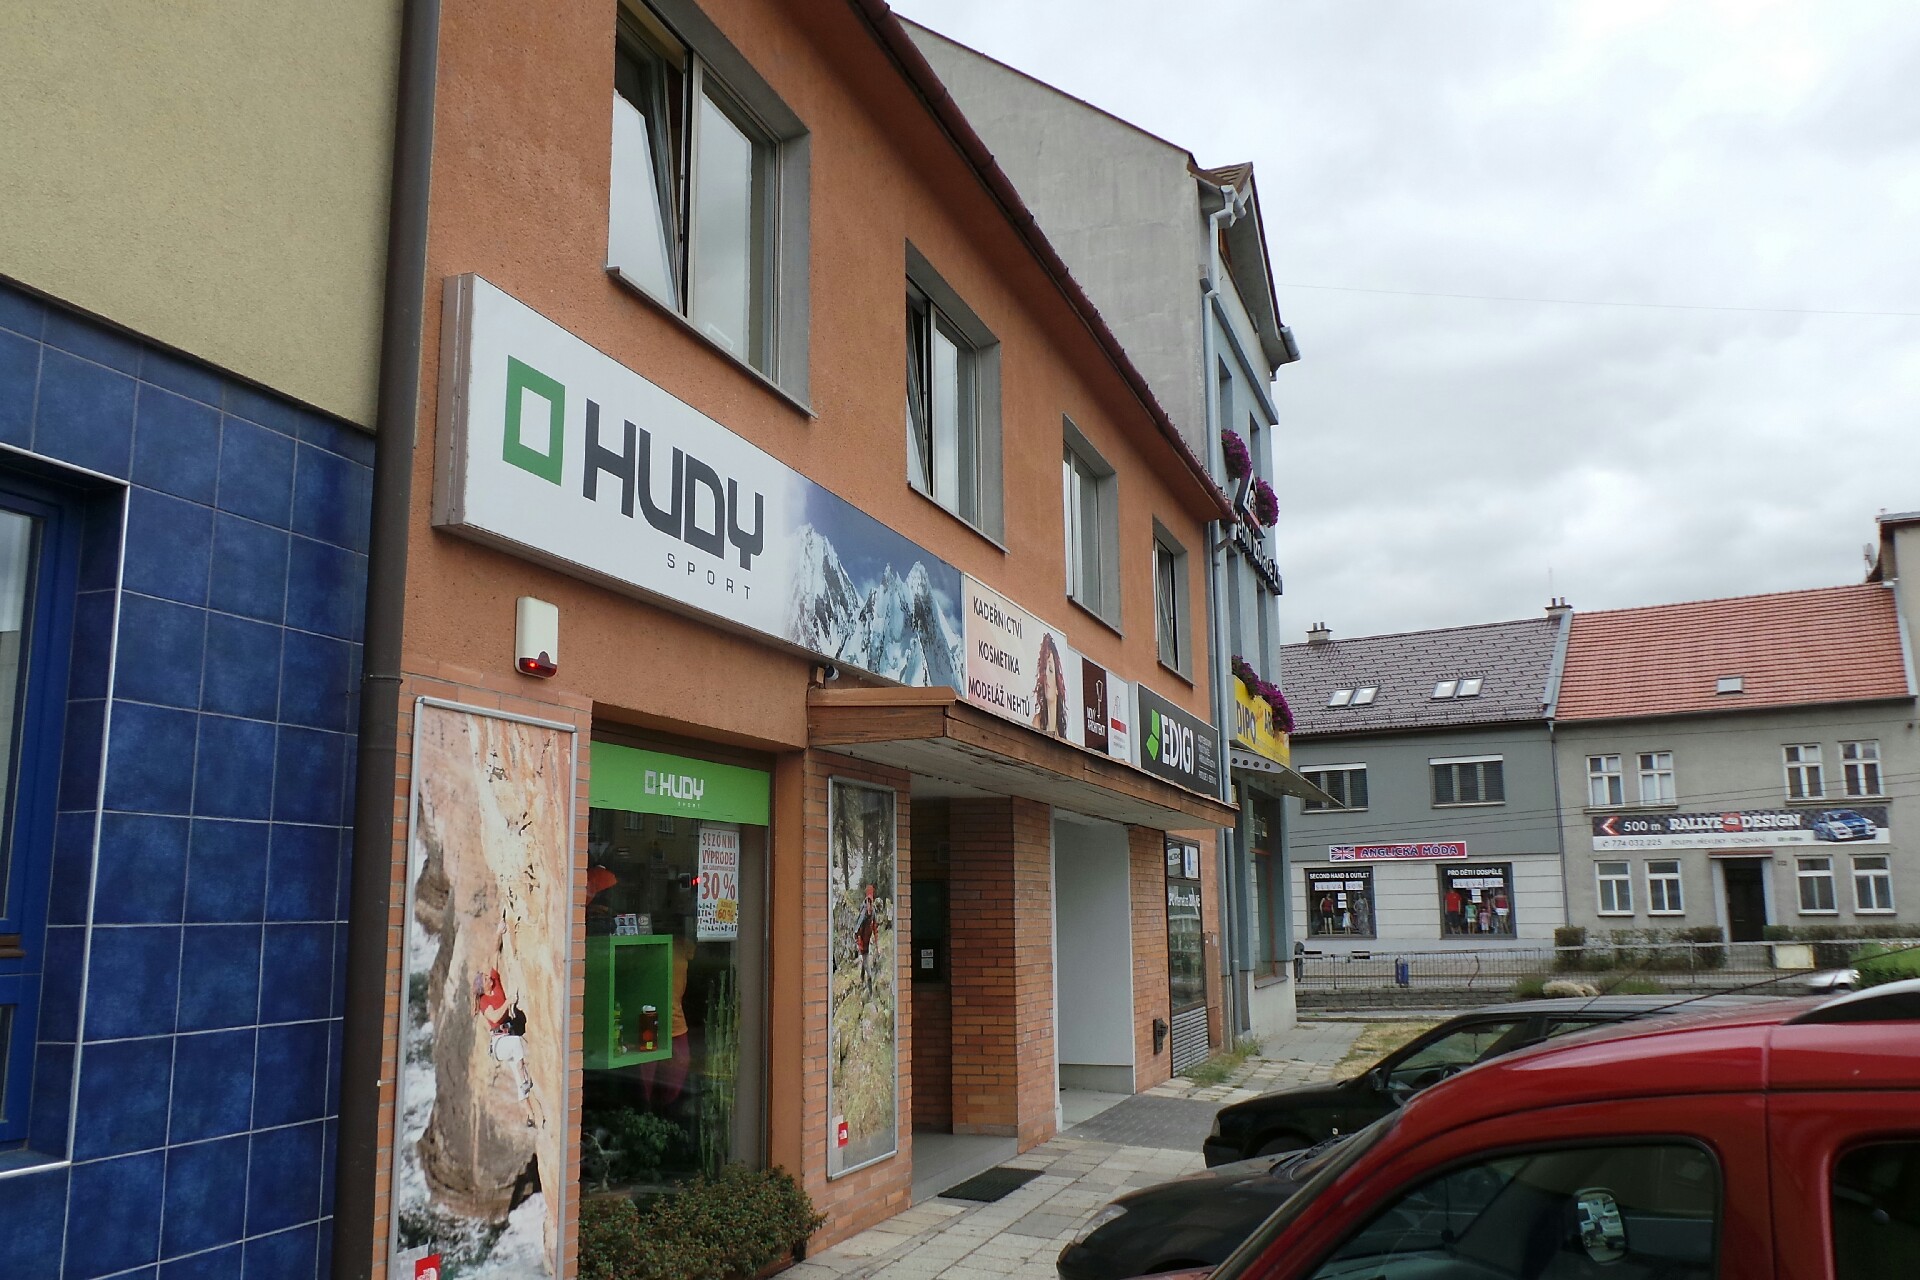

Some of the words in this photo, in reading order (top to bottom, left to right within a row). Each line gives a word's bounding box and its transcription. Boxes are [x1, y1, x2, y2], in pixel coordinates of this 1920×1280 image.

[583, 398, 763, 571] HUDY
[667, 552, 751, 600] SPORT
[973, 596, 1022, 639] KADEŘNICTVÍ
[978, 640, 1020, 675] KOSMETIKA
[968, 676, 1005, 708] MODELÁŽ
[1006, 693, 1030, 717] NEHTŮ
[1160, 713, 1194, 775] EDIGI
[660, 772, 704, 800] HUDY
[1623, 821, 1648, 832] 500
[1650, 823, 1661, 831] m
[1669, 817, 1723, 830] RALLYE
[1741, 814, 1801, 828] DESIGN
[702, 832, 736, 849] SEZÓNNÍ
[1360, 844, 1419, 858] ANGLICKÁ
[1422, 843, 1459, 856] MÓDA
[1611, 840, 1627, 848] 774
[1628, 839, 1646, 847] 032
[702, 848, 736, 866] VÝPRODEJ
[702, 872, 720, 900] 30
